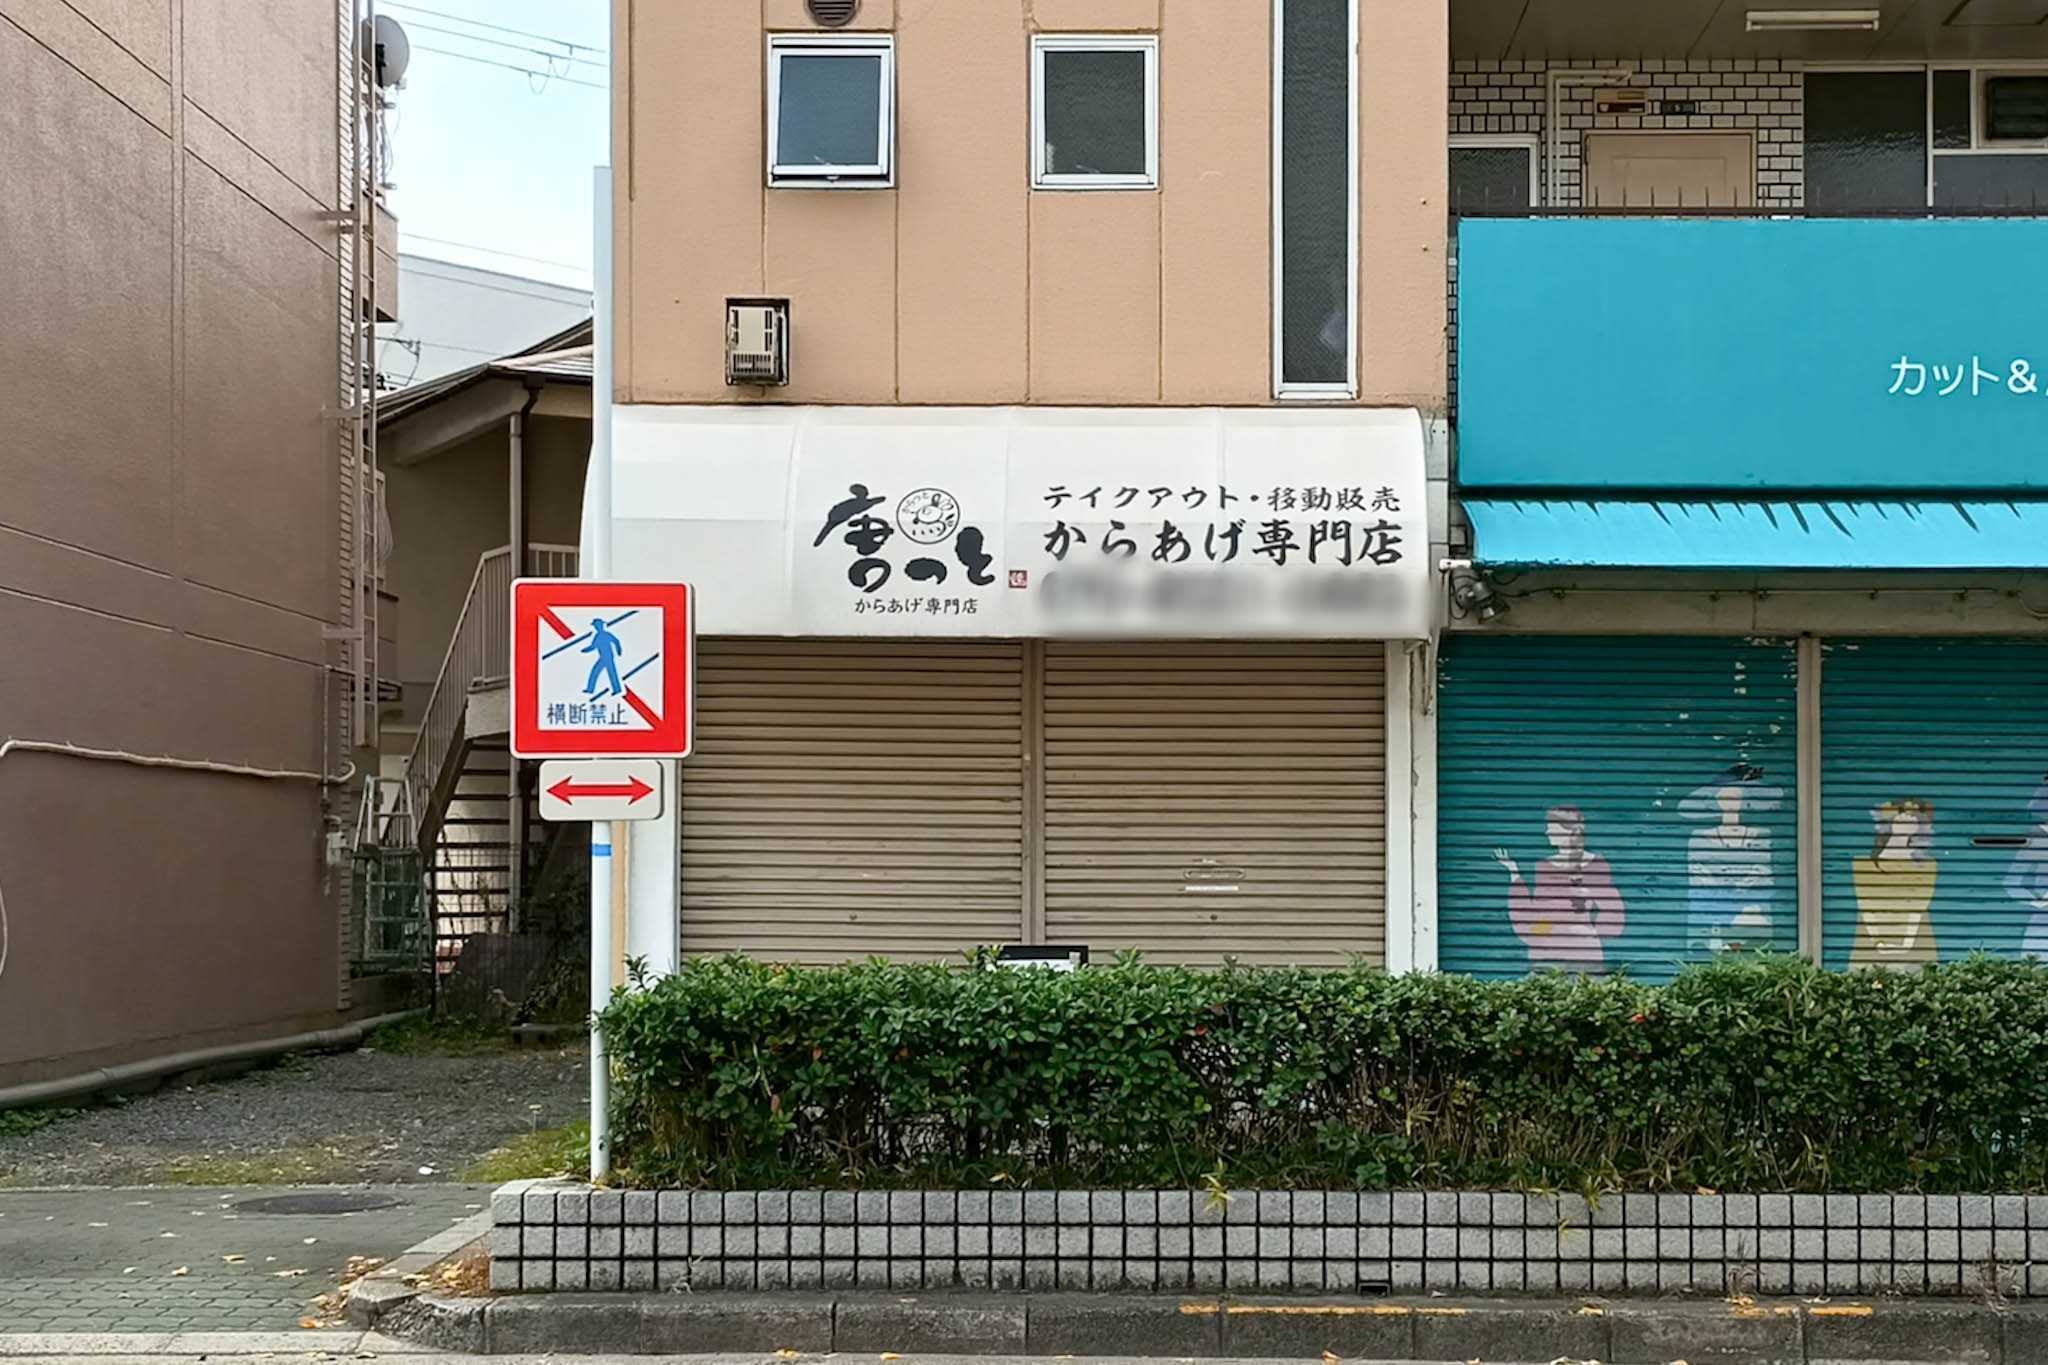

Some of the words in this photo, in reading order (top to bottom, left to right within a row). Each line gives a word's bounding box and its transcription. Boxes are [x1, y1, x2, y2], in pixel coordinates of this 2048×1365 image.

[1888, 355, 2048, 396] カット&
[1043, 485, 1401, 512] テイクアウト・移動販売
[1043, 519, 1403, 567] からあげ専門店
[854, 597, 978, 615] からあげ専門店
[546, 702, 629, 725] 横断禁止
